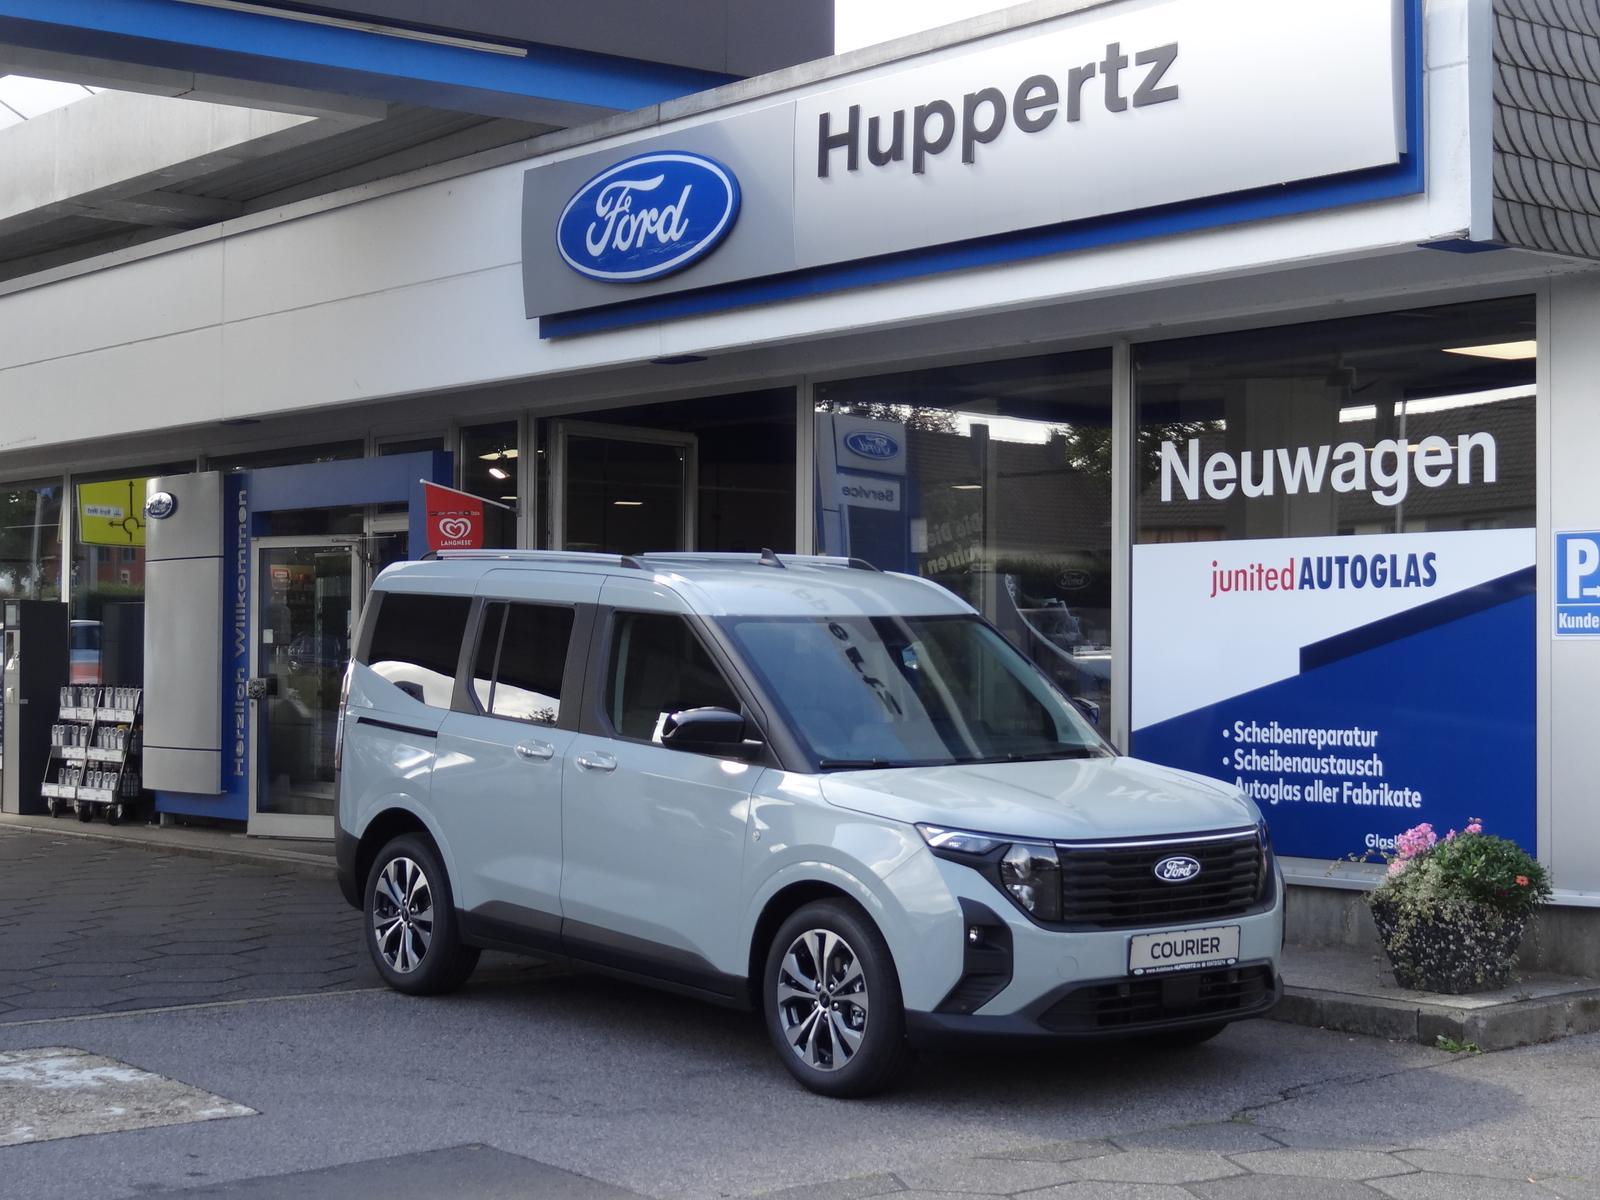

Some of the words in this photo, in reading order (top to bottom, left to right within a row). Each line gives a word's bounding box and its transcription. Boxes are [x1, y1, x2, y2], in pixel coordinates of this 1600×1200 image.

[817, 41, 1179, 178] Huppertz
[586, 174, 692, 256] Ford
[1160, 430, 1497, 507] Neuwagen
[440, 539, 472, 547] LANGNESE
[235, 489, 247, 658] Willkommen
[1210, 558, 1295, 598] junited
[1298, 551, 1438, 591] AUTOGLAS
[1566, 538, 1600, 599] P
[234, 667, 245, 777] Herzlich
[1234, 720, 1379, 751] Scheibenreparatur
[1233, 748, 1384, 777] Scheibenaustausch
[1234, 776, 1301, 805] Autoglas
[1304, 779, 1340, 803] aller
[1342, 781, 1422, 809] Fabrikate
[1163, 860, 1192, 878] Ford
[1150, 936, 1220, 959] COURIER
